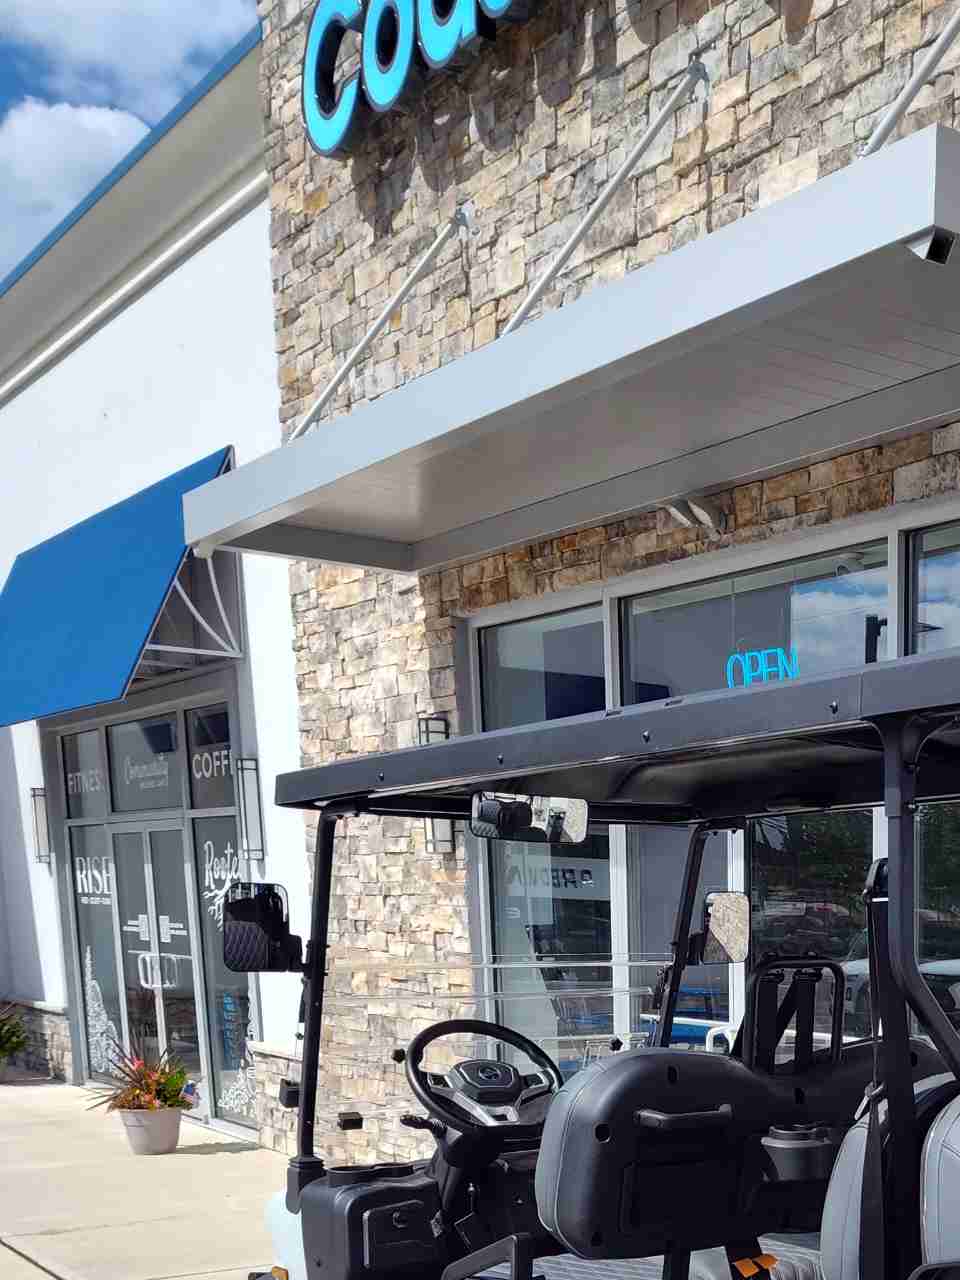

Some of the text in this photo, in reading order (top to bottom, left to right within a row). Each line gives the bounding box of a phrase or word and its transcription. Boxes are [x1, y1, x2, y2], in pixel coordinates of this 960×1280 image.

[302, 0, 513, 158] Coa
[727, 647, 799, 689] OPEN
[192, 749, 233, 779] COFF
[76, 856, 112, 894] RISE
